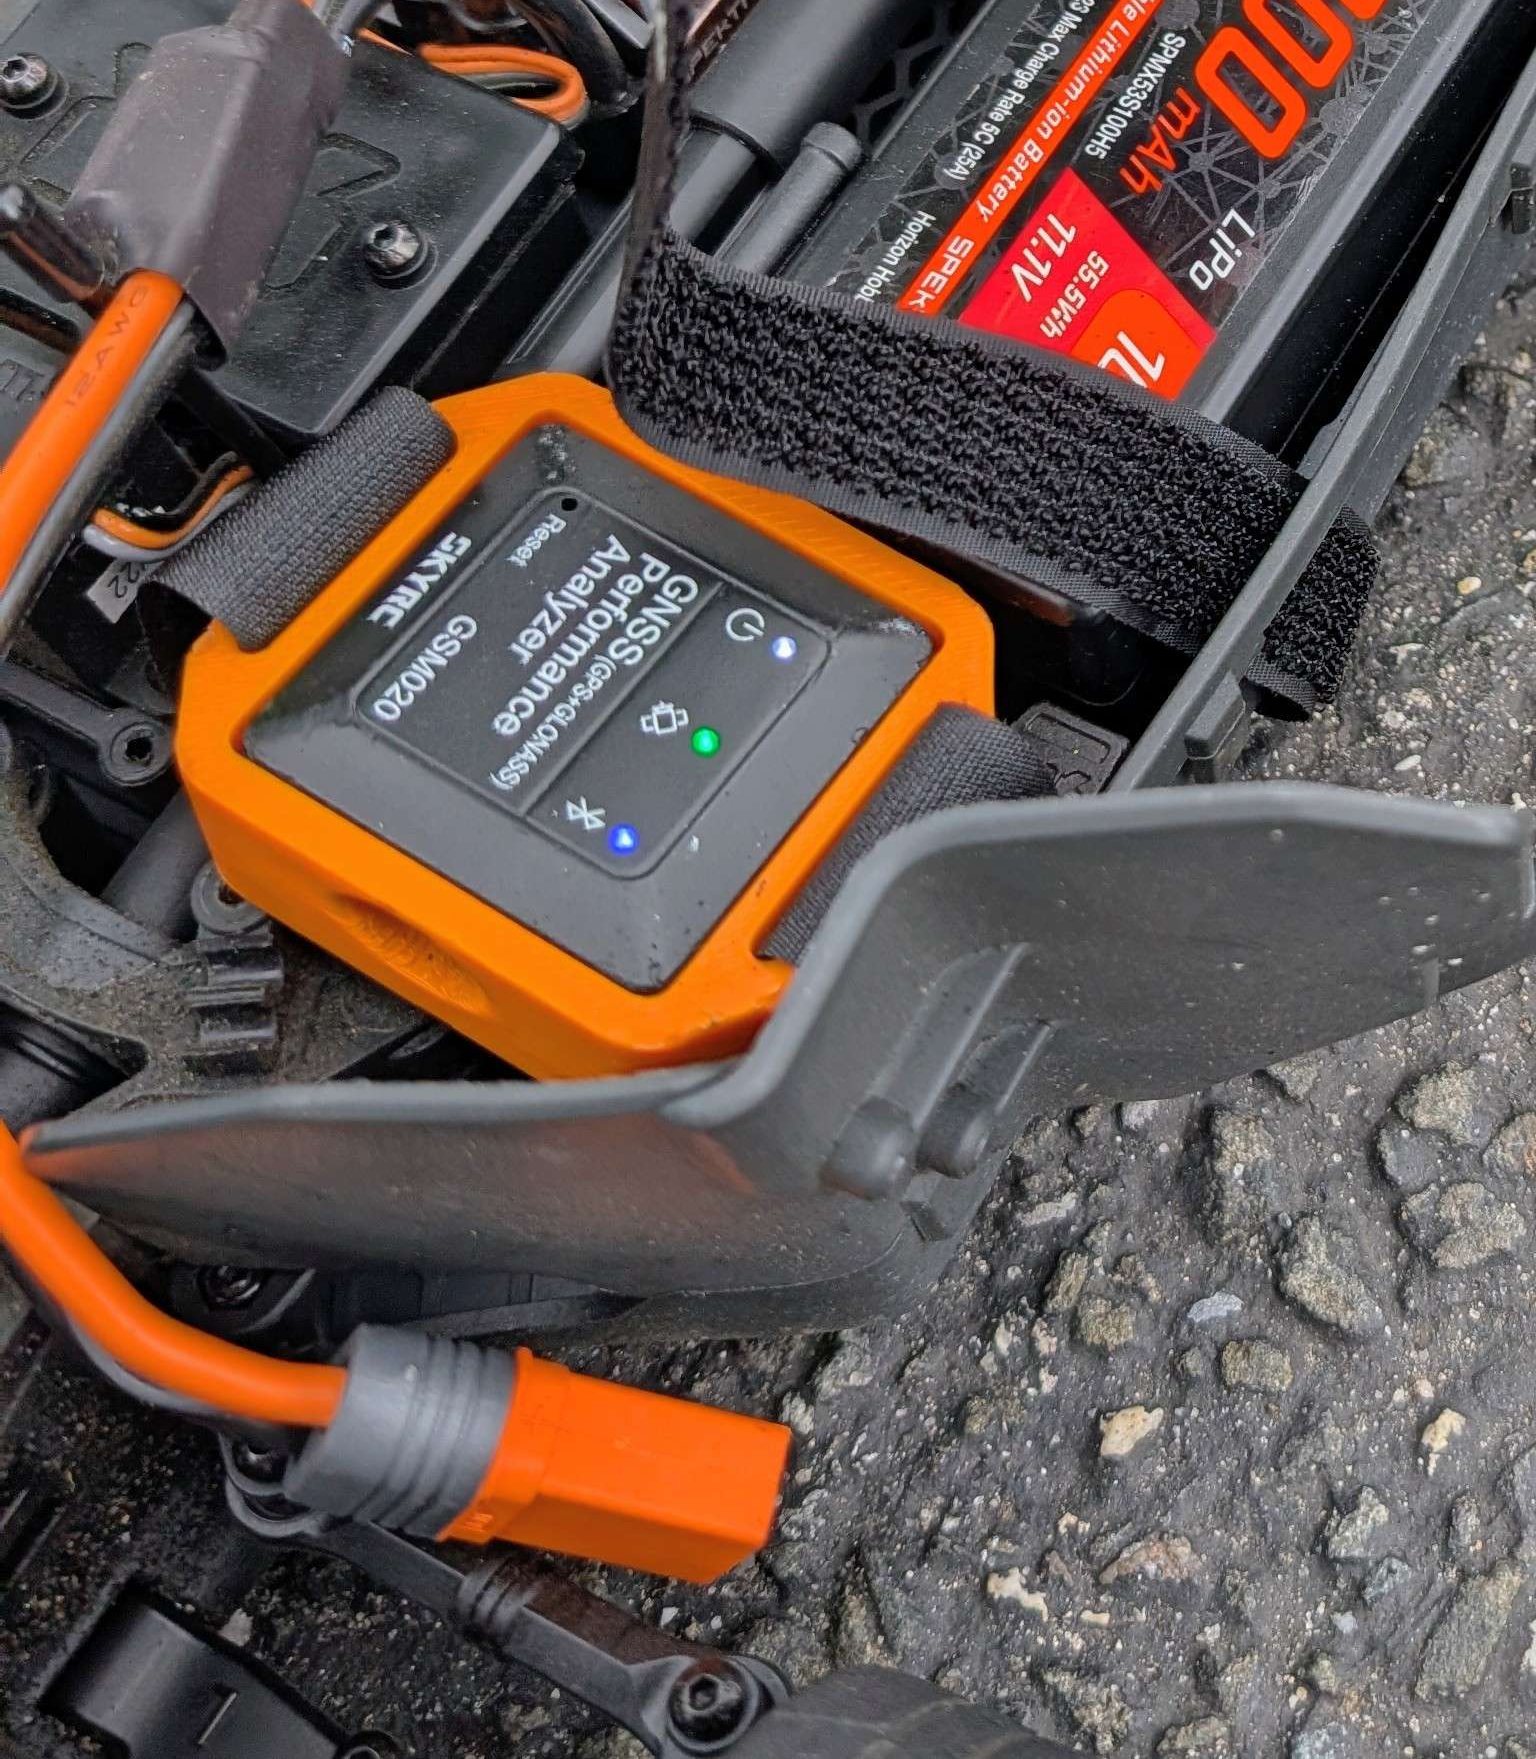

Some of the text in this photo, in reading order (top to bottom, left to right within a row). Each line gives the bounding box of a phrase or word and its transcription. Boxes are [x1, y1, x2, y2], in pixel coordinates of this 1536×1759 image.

[1013, 41, 1061, 90] Charge
[1047, 11, 1084, 43] Max
[988, 86, 1026, 124] Rate
[1040, 19, 1131, 140] Lithium-ion
[1084, 32, 1187, 160] SPMX53S100H5
[943, 141, 986, 181] (25A)
[974, 121, 1001, 147] 5C
[1119, 88, 1200, 195] mAh
[975, 138, 1045, 223] Battery
[887, 209, 936, 267] Horizon
[908, 235, 975, 312] SPEK
[1011, 213, 1077, 303] 11.1V
[1188, 208, 1256, 292] LiPo
[1039, 250, 1110, 339] 55.5Wh
[367, 532, 472, 629] SKYRC
[507, 513, 567, 567] Reset
[509, 533, 632, 666] Analyzer
[373, 614, 478, 722] GSM020
[489, 575, 698, 791] GNSS (GPS+GLONASS)
[492, 552, 671, 735] Performance
